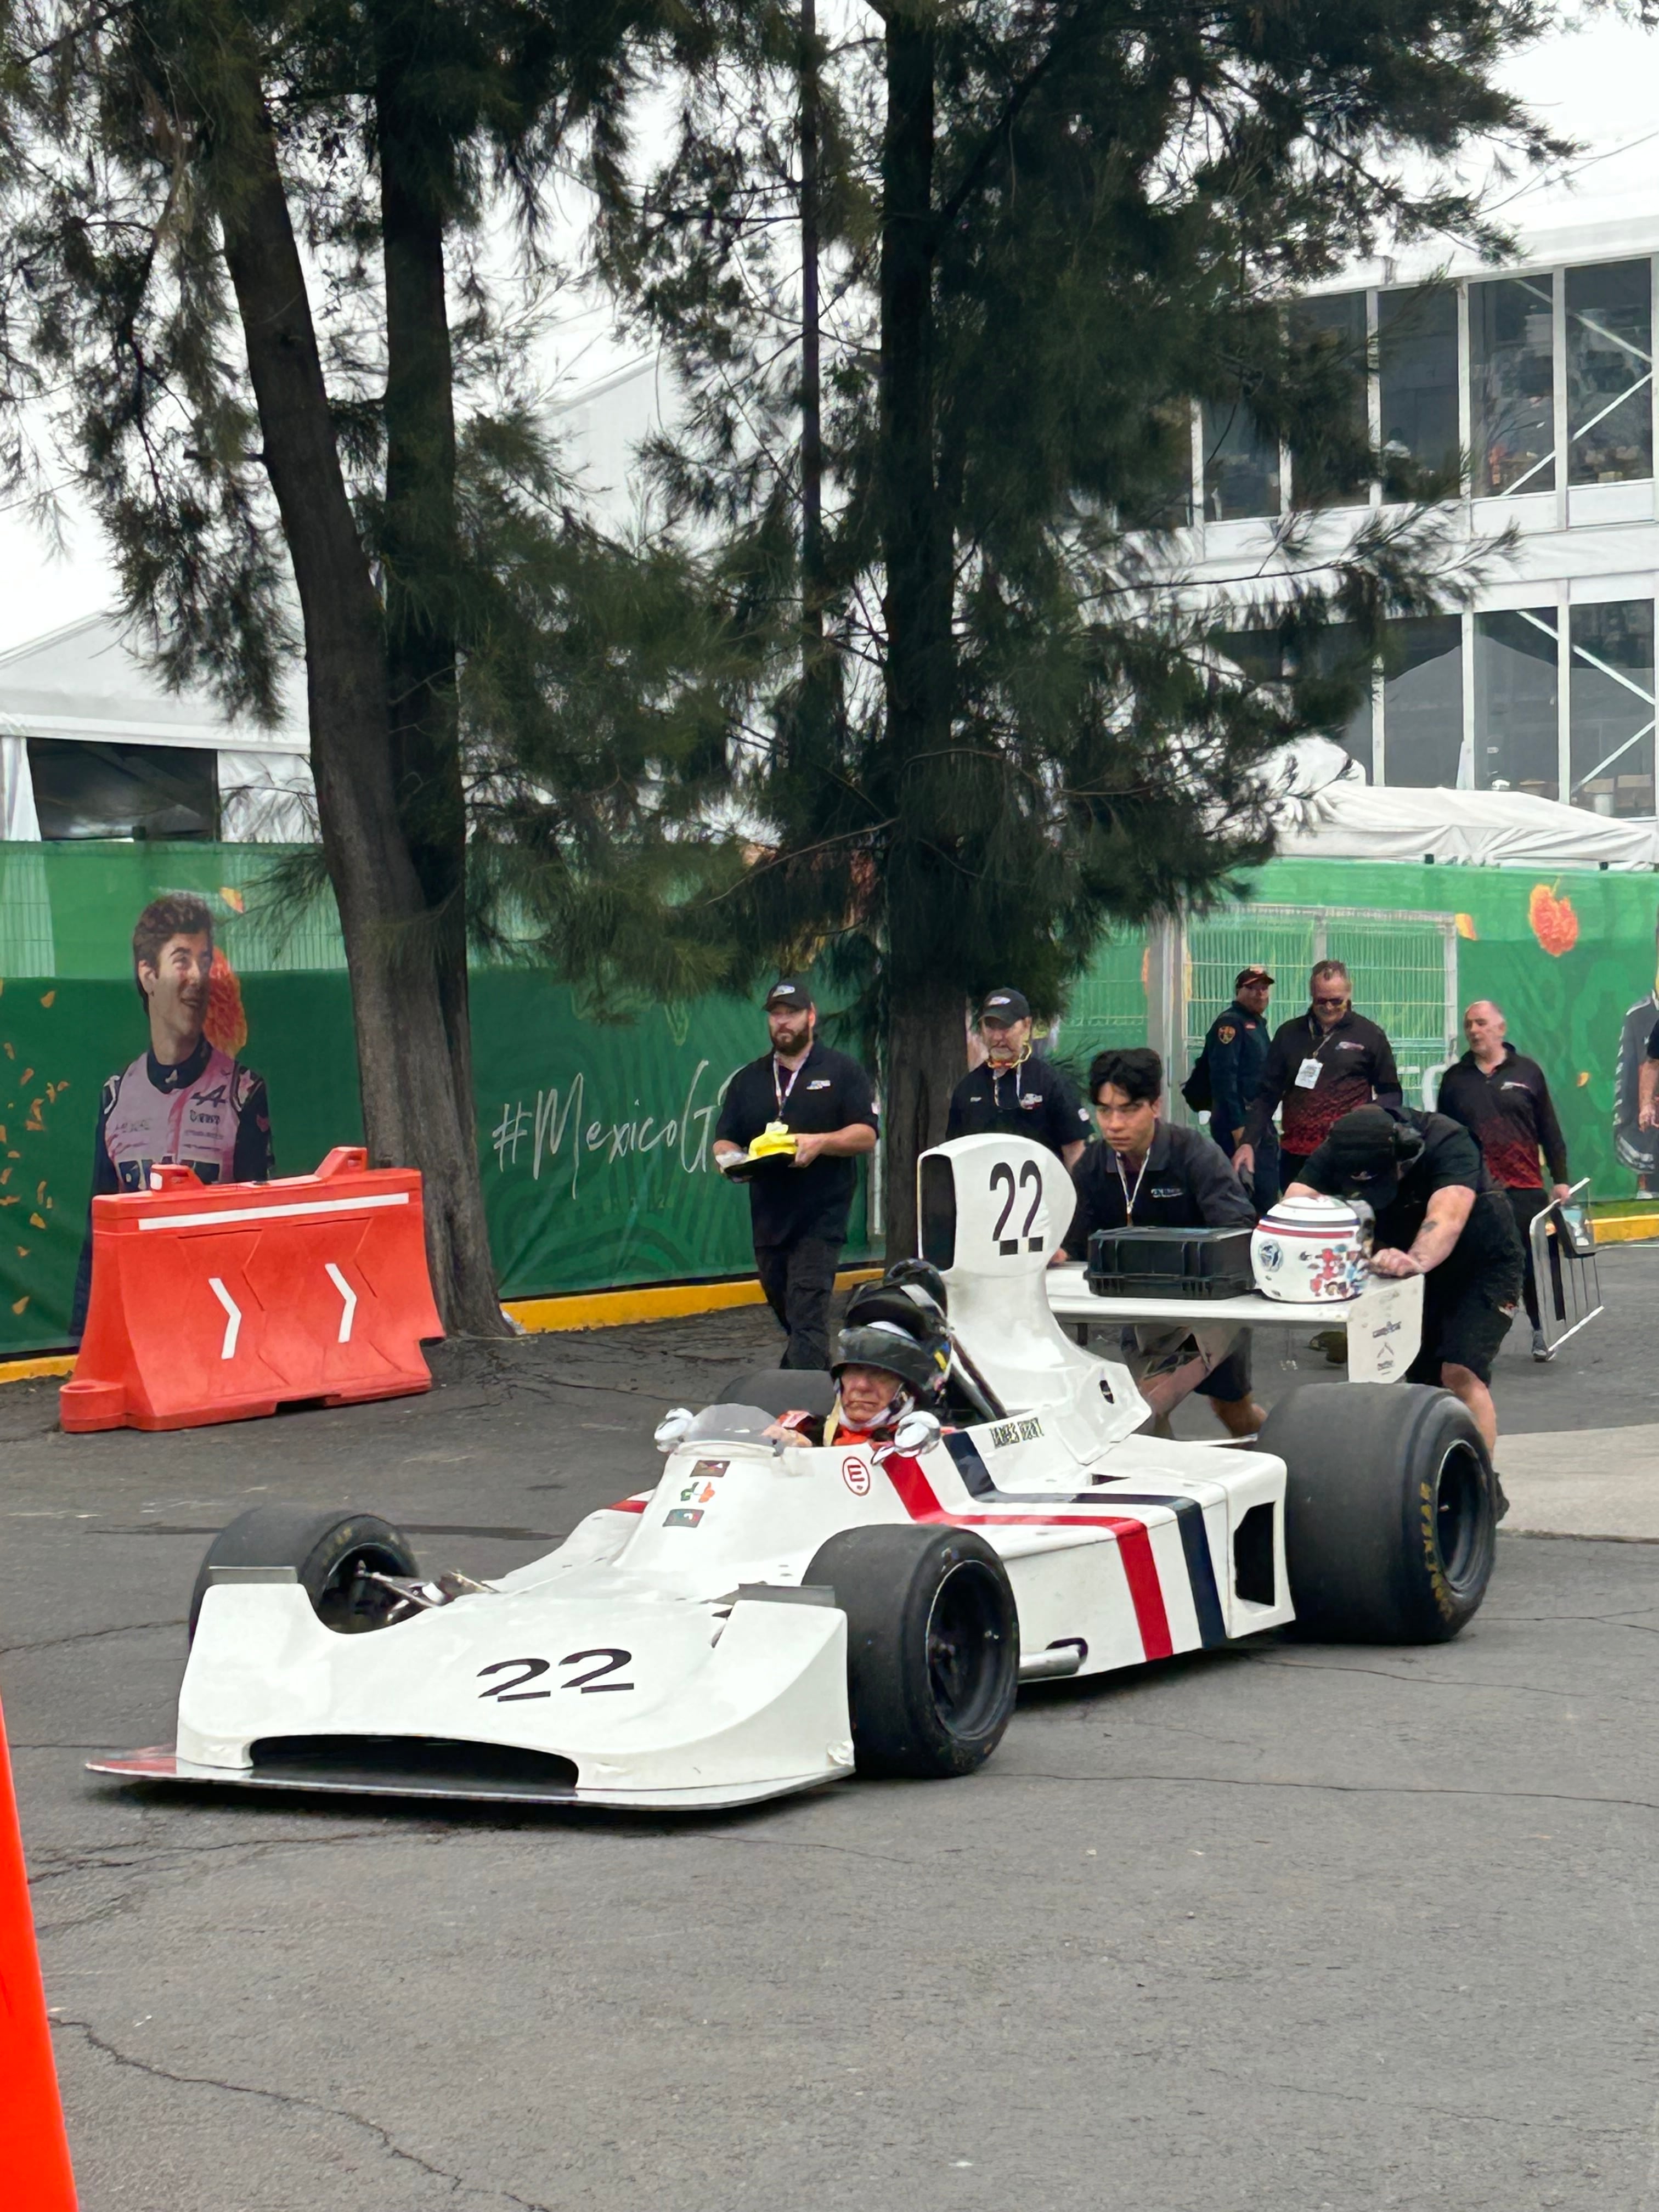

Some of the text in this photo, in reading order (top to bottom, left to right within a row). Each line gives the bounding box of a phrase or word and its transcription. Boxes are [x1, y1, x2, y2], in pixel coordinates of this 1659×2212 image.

[492, 1059, 748, 1200] #MexicoG
[989, 1160, 1044, 1256] 22
[476, 1648, 635, 1703] 22
